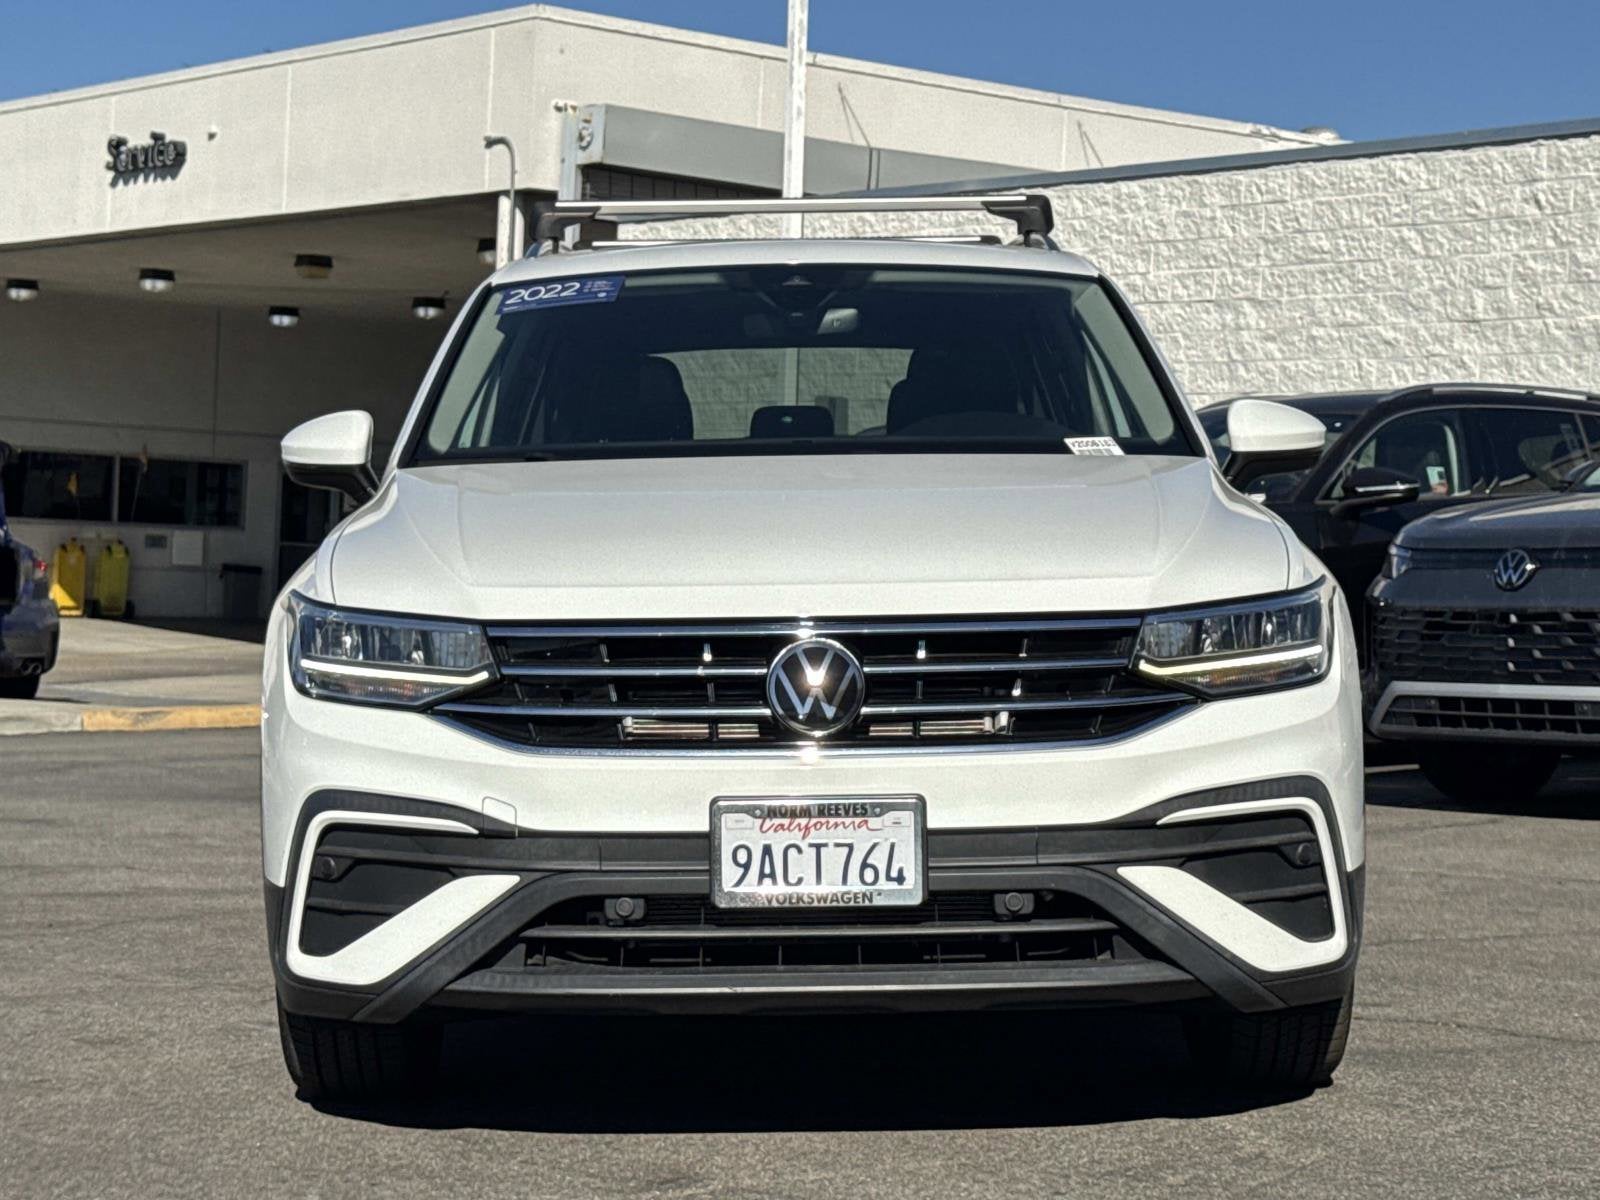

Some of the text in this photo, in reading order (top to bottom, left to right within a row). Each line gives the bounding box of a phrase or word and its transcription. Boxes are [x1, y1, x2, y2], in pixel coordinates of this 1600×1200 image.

[105, 131, 187, 173] Service
[505, 282, 581, 305] 2022
[766, 803, 869, 818] NORM REEVES
[759, 816, 883, 840] California
[731, 841, 907, 888] 9ACT764
[764, 891, 874, 905] VOLKSWAGEN
